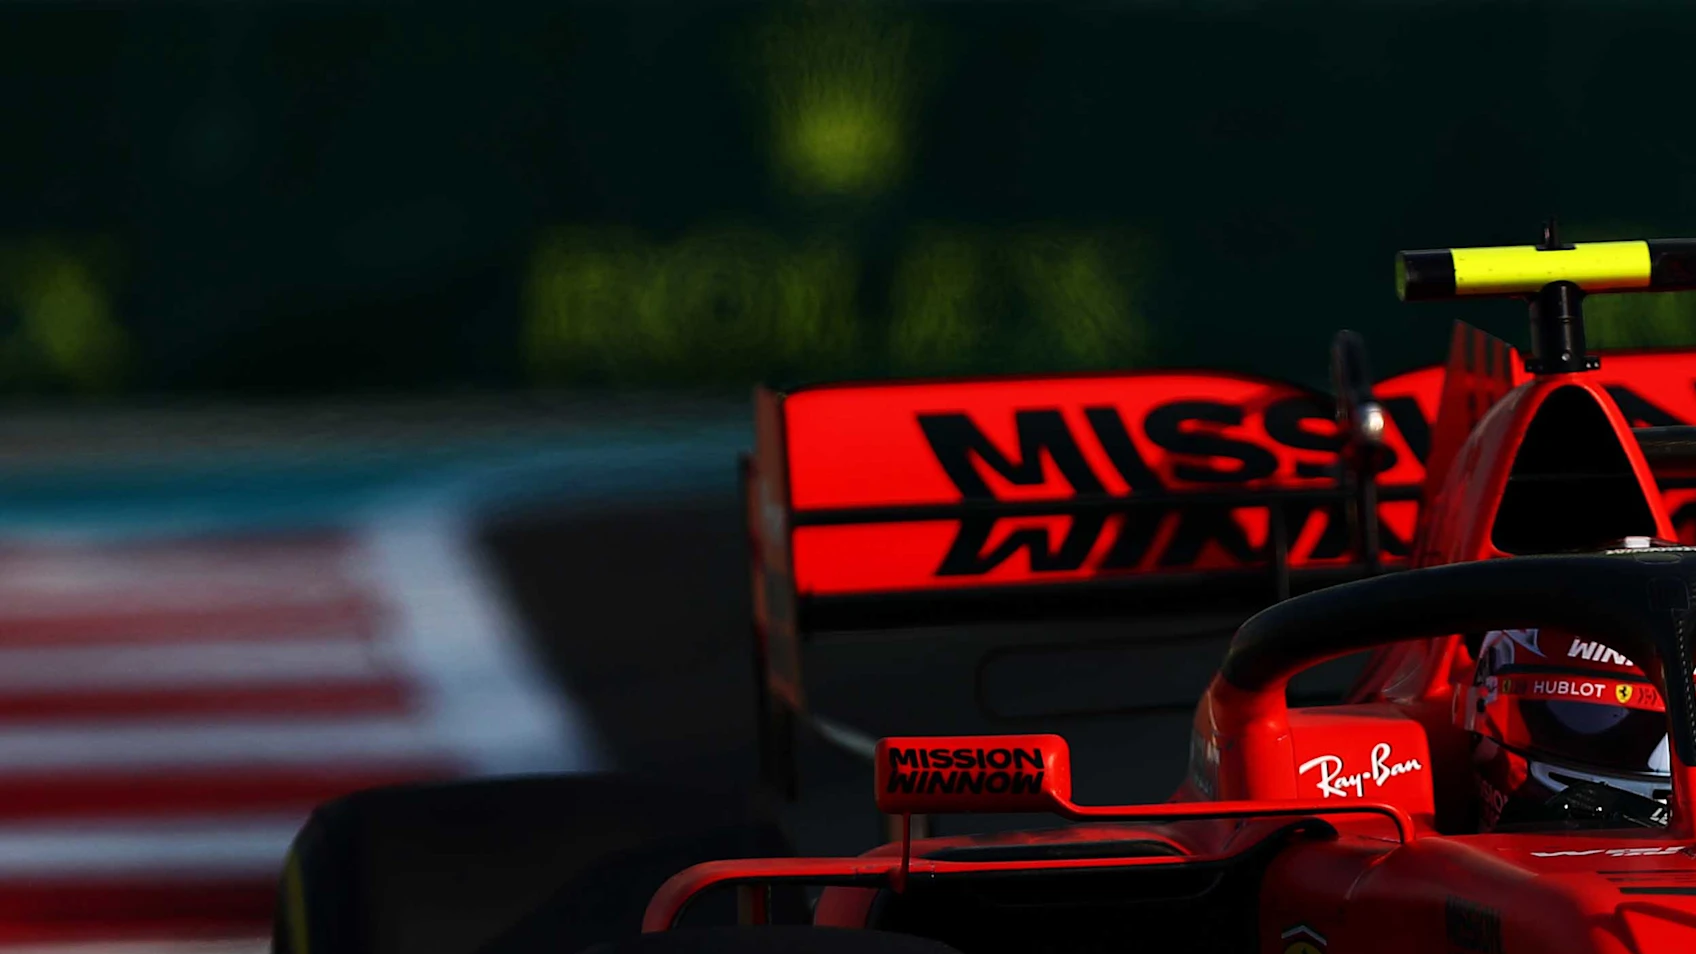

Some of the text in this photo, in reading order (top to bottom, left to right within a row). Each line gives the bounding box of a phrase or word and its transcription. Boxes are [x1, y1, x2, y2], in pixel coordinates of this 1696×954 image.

[1533, 681, 1606, 698] HUBLOT
[887, 747, 1044, 771] MISSION
[1299, 742, 1422, 798] Ray-Ban
[886, 771, 1043, 795] WINNOW
